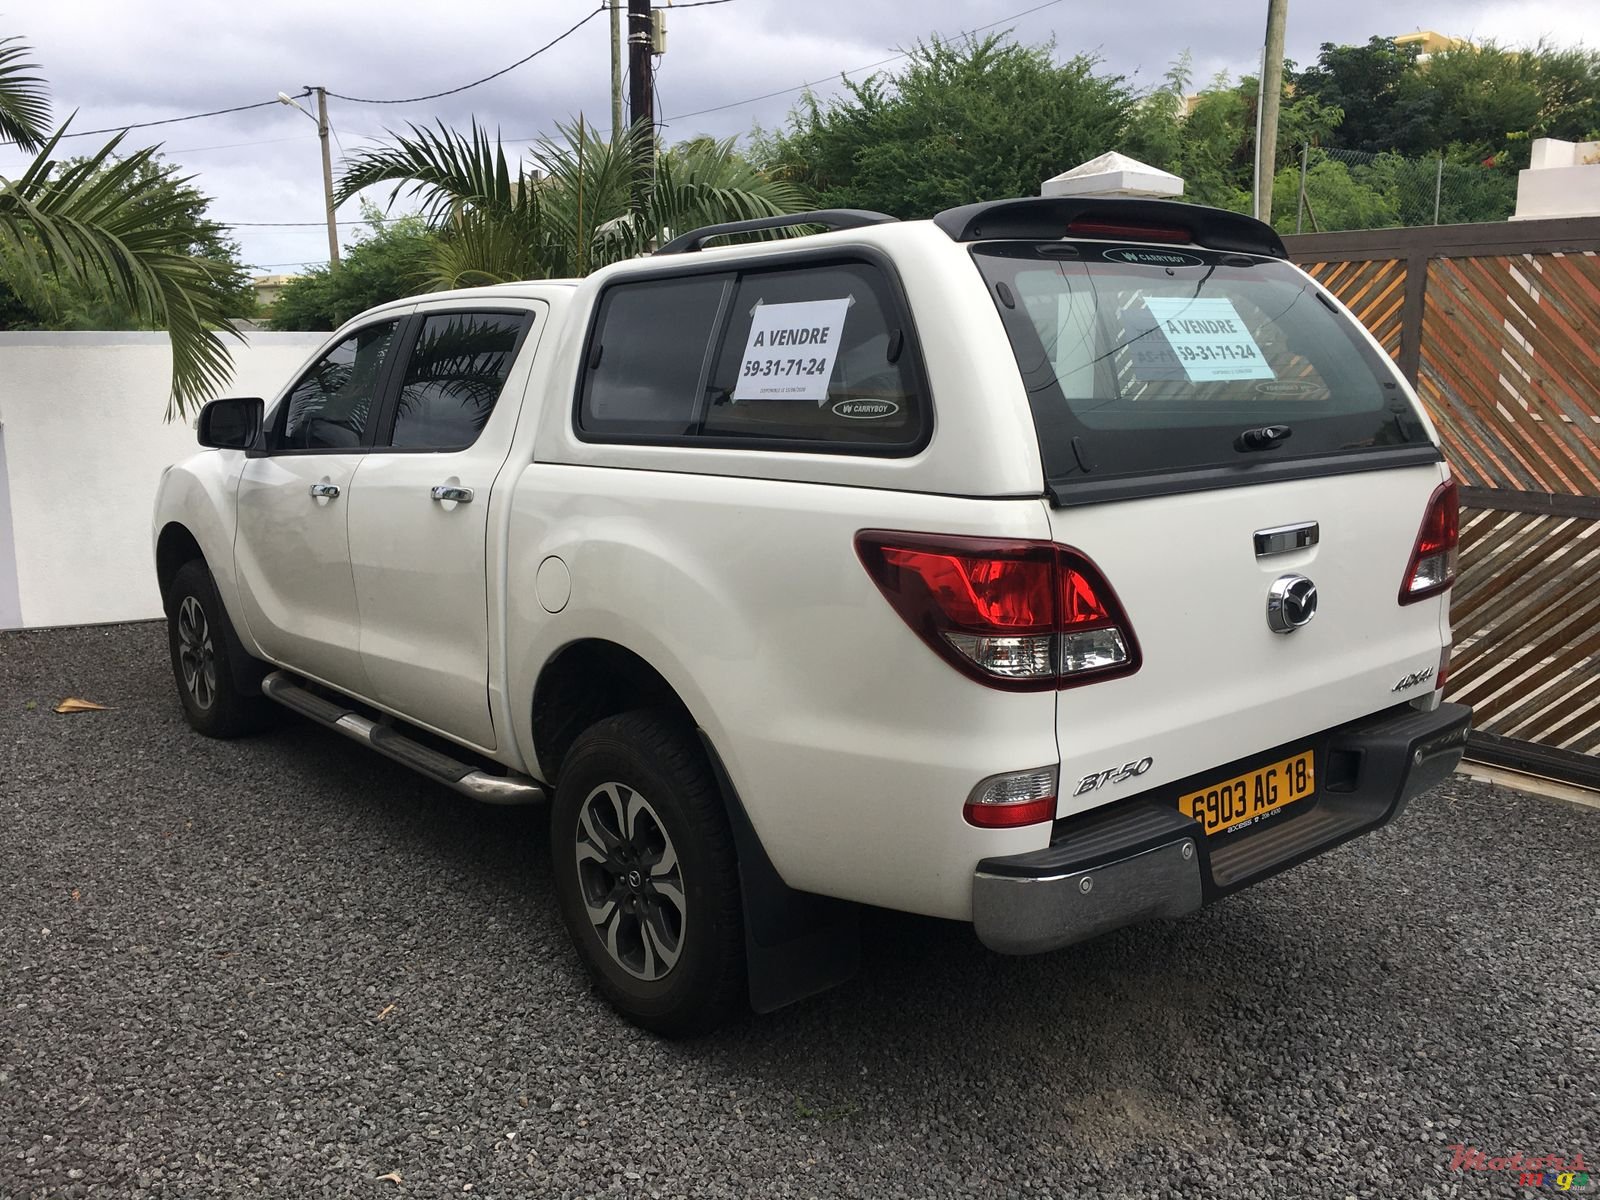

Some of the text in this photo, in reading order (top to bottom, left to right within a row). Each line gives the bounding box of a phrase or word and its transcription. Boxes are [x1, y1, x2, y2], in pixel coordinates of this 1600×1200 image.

[1138, 254, 1186, 264] CARRYBOY
[1166, 319, 1181, 334] A
[1177, 319, 1238, 334] VENDRE
[753, 327, 830, 347] A VENDRE
[1177, 344, 1256, 360] 59-31-71-24
[743, 358, 826, 377] 59-31-71-24
[853, 405, 888, 413] CARRYBOY
[1073, 757, 1154, 797] BT-50
[1192, 758, 1307, 829] 6903 AG 18
